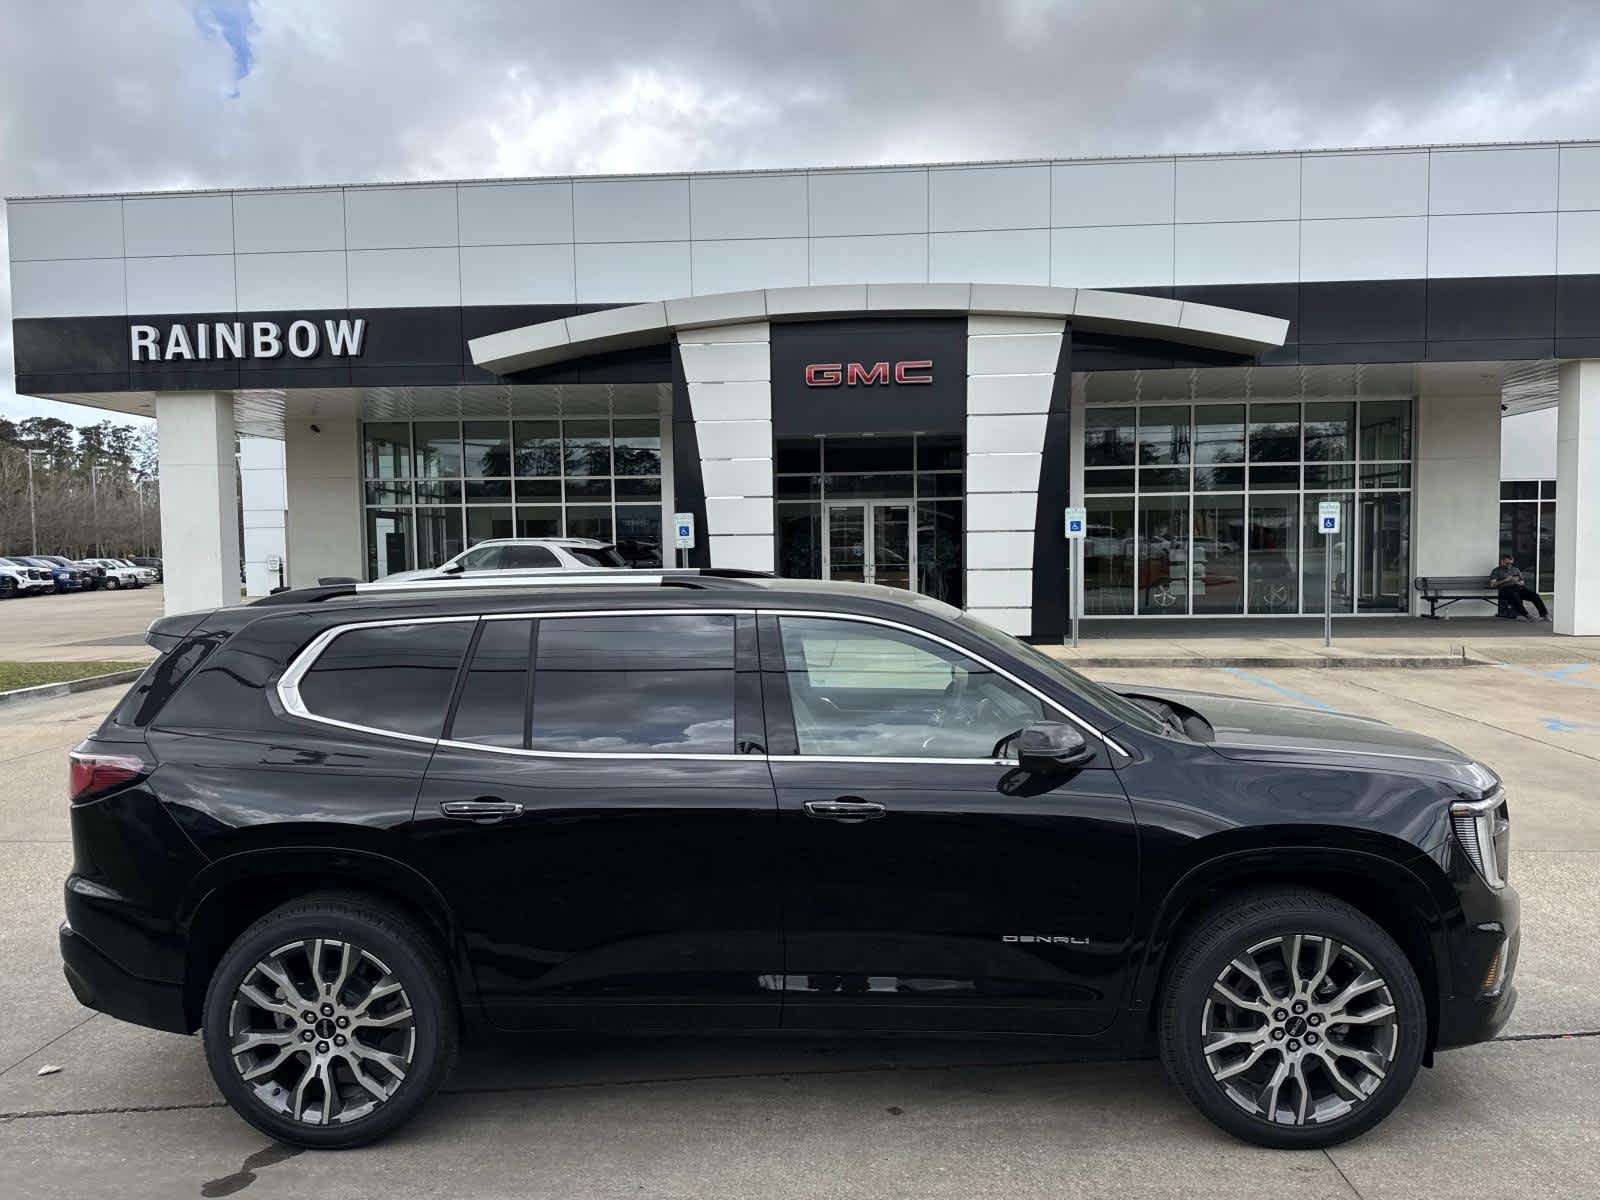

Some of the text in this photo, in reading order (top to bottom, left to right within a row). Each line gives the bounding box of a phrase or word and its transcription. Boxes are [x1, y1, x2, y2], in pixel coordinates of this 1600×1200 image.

[131, 319, 365, 361] RAINBOW
[805, 360, 933, 386] GMC
[1002, 935, 1090, 945] DENALI
